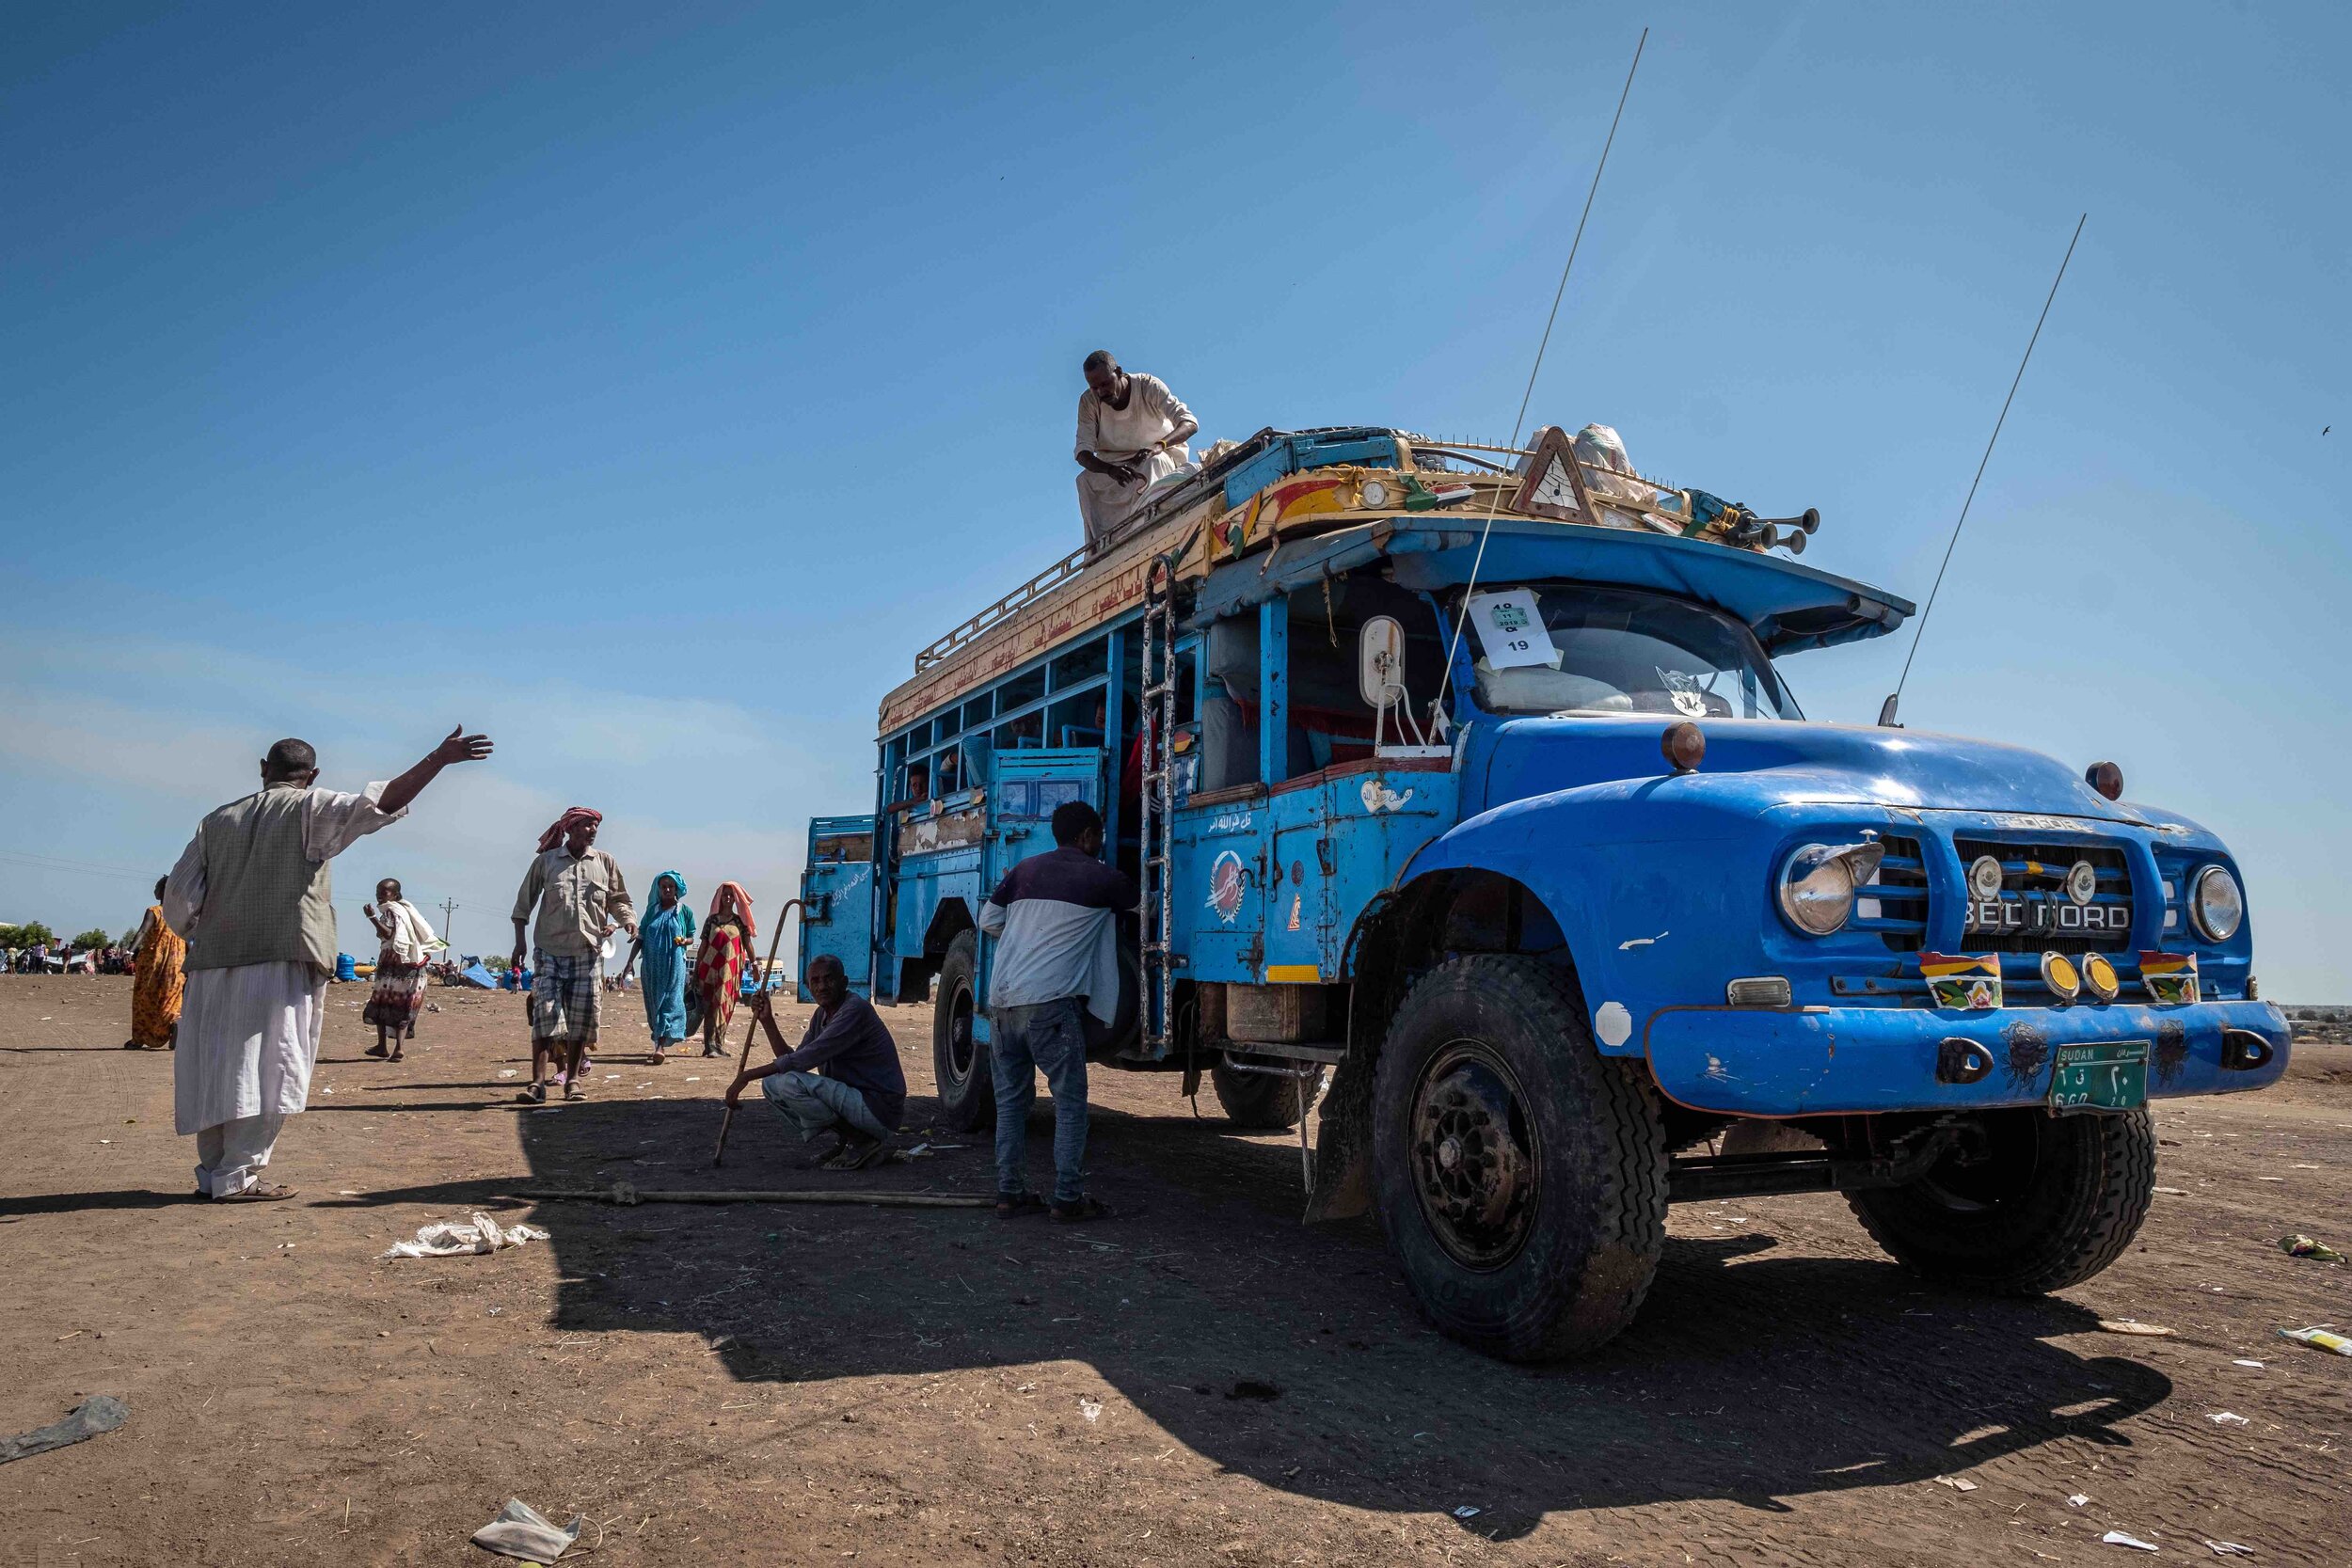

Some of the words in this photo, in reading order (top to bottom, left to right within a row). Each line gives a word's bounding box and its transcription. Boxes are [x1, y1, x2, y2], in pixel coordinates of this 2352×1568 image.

[1508, 641, 1529, 651] 19
[1218, 815, 1232, 830] الله
[2060, 1049, 2094, 1061] SUDAN
